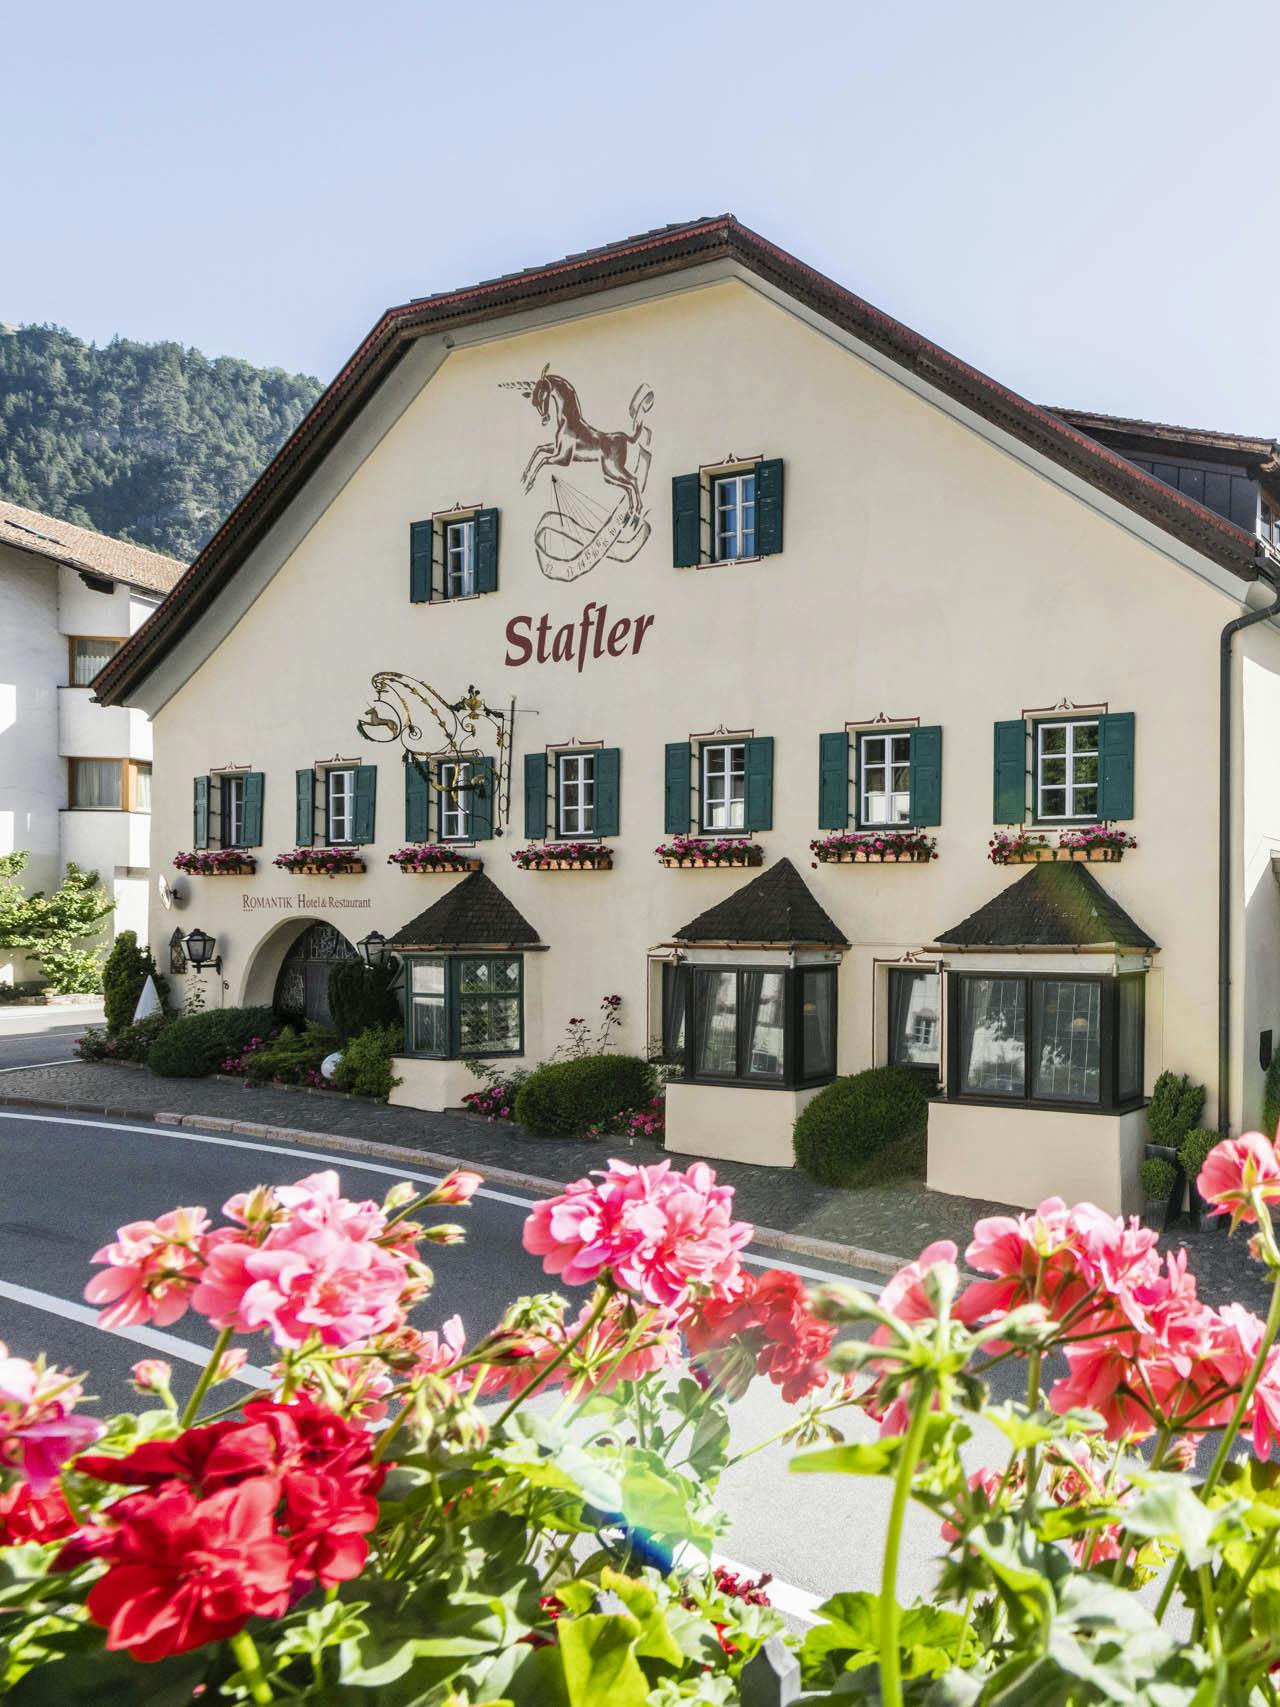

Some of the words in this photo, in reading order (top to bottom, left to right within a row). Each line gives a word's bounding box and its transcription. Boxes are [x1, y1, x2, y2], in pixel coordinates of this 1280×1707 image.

[504, 601, 655, 673] Stafler
[242, 894, 293, 909] ROMANTIK
[297, 893, 320, 909] Hotel
[328, 896, 371, 909] Restaurant
